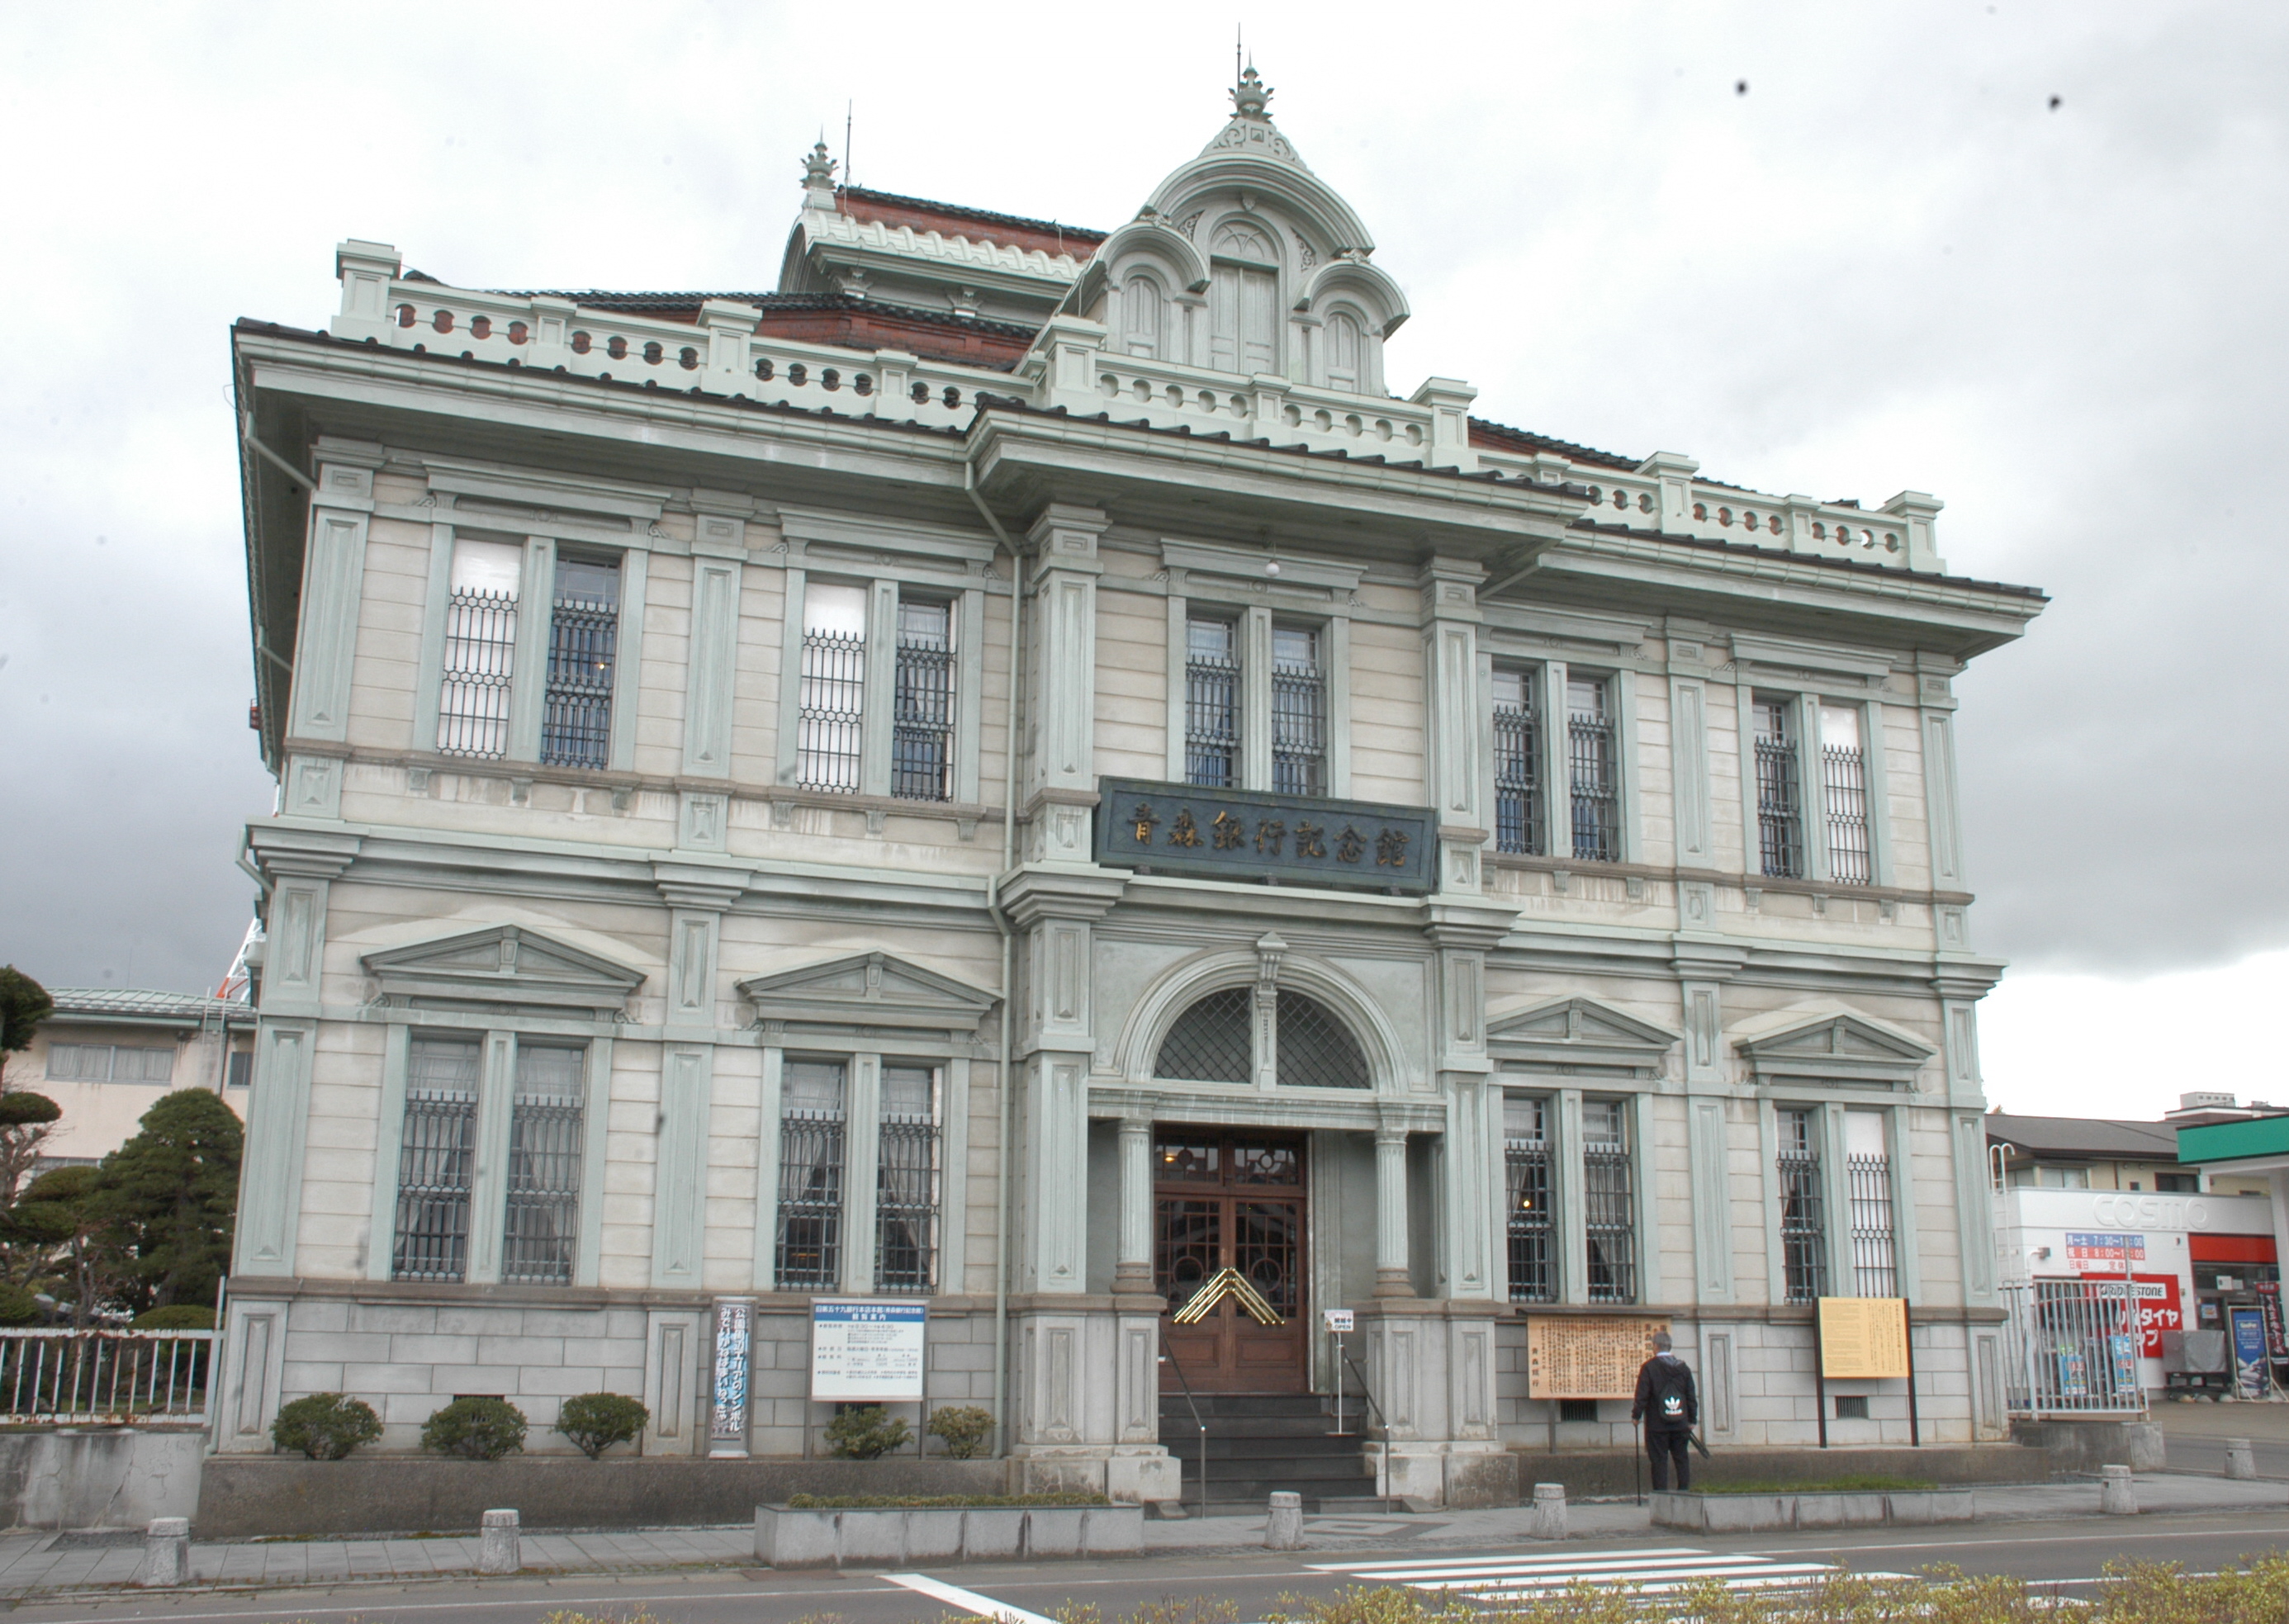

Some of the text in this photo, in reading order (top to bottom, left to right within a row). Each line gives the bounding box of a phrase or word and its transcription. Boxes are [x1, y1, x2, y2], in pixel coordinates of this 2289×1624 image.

[1128, 803, 1410, 867] 青森銀行記念館
[2093, 1235, 2143, 1247] 7:30～1:00
[2094, 1248, 2144, 1259] 8:00～1:00
[2101, 1284, 2163, 1297] BRDESTONE
